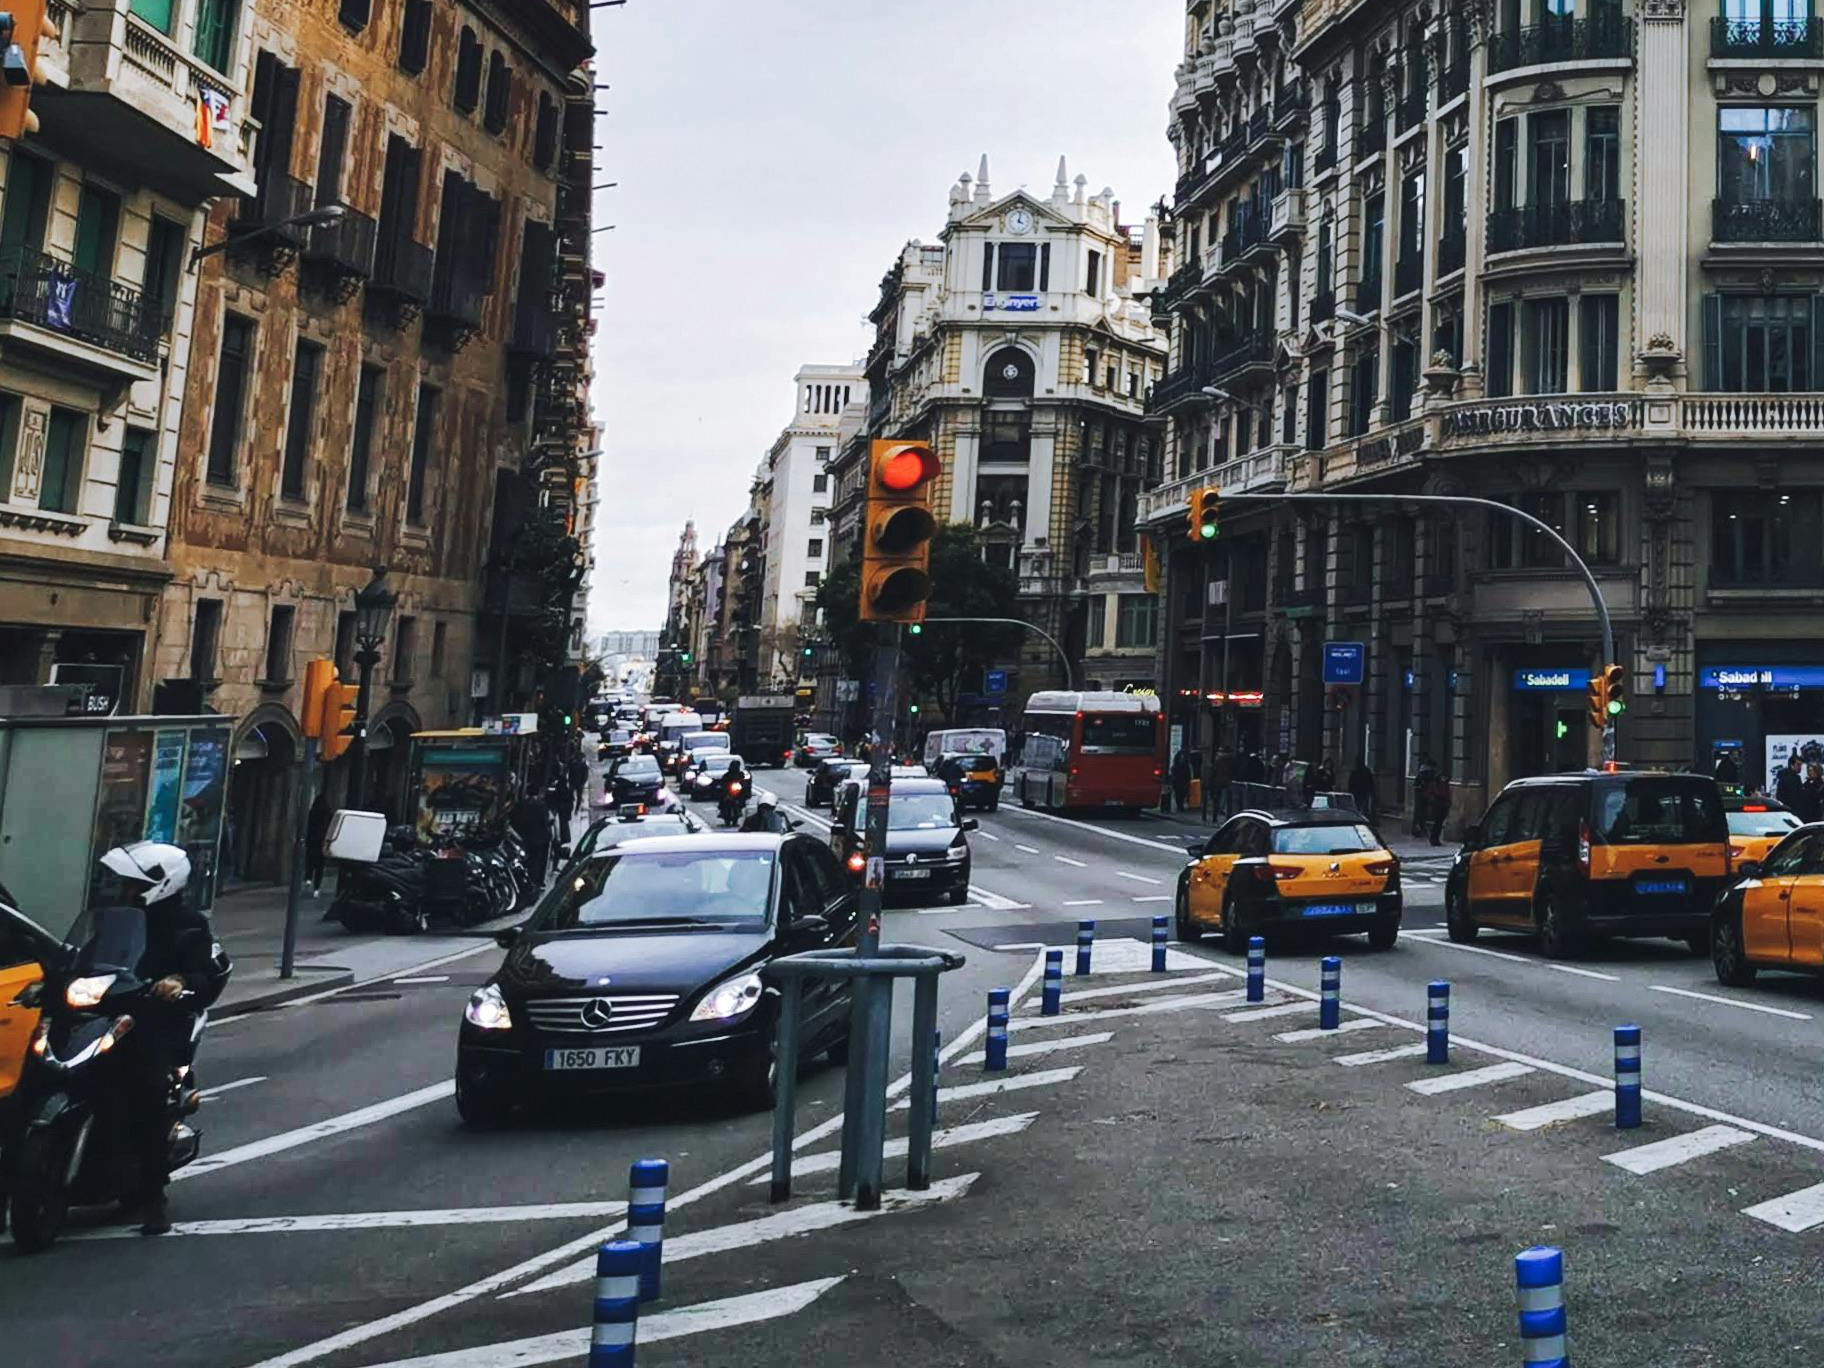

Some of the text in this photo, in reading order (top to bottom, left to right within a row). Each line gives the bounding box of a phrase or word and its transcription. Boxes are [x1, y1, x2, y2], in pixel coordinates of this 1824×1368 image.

[1527, 673, 1570, 686] Sabadell
[558, 1048, 636, 1068] 1650 FKY
